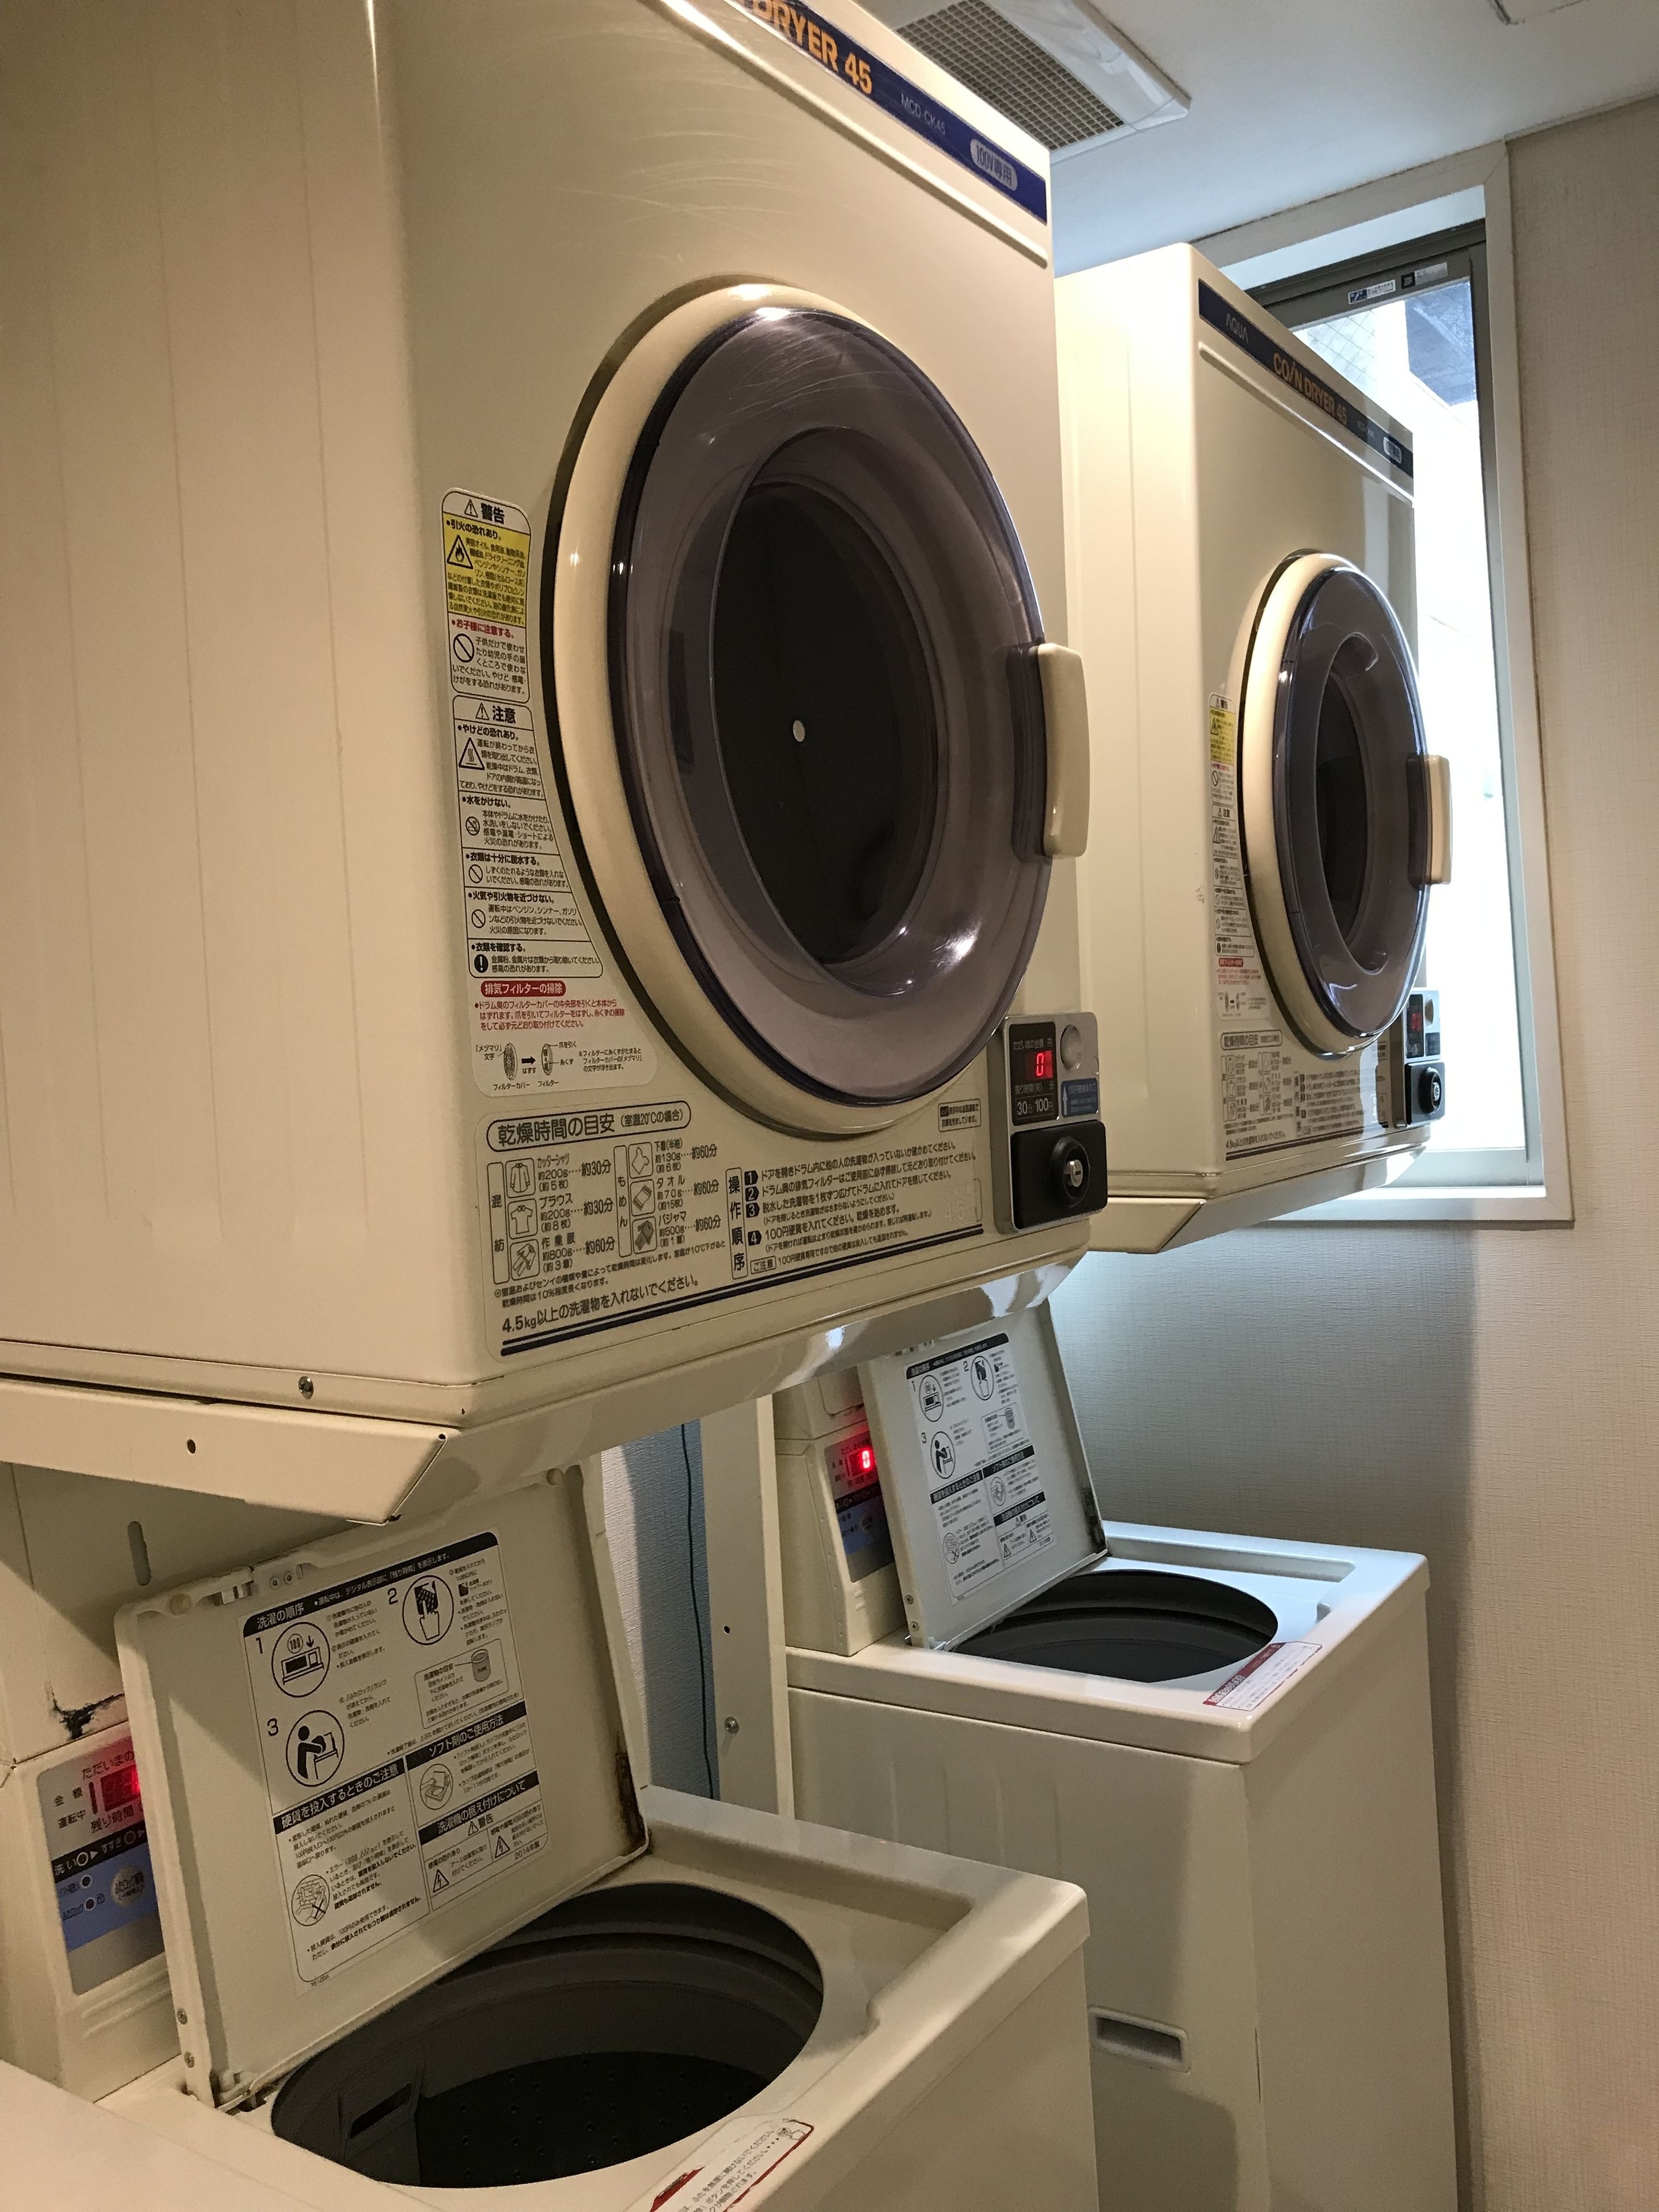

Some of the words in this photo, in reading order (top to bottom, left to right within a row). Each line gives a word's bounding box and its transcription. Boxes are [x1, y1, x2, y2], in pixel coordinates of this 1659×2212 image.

[753, 0, 838, 73] DRYER
[844, 52, 872, 94] 45
[1225, 313, 1249, 344] AQUA
[1304, 377, 1335, 415] DRYER
[1336, 403, 1348, 425] 45
[480, 502, 505, 525] 警告
[450, 518, 502, 541] 引火の恐れあり。
[456, 619, 514, 639] お子様に注意する。
[475, 636, 525, 653] 子供だけで使わせ
[476, 660, 525, 674] くところで使わな
[492, 704, 517, 724] 注意
[463, 725, 519, 741] やけどの恐れあり。
[467, 795, 512, 808] 水をかけない。
[470, 851, 540, 866] 衣類は十分に脱水する。
[472, 892, 555, 904] 火気や引火物を近づけない。
[489, 925, 547, 935] 火災の原因になります。
[475, 942, 526, 953] 衣類を確認する。
[484, 982, 563, 995] 排気フィルターの掃除
[1036, 1052, 1044, 1077] 0
[493, 1082, 531, 1091] フィルターカバー
[537, 1080, 559, 1088] フィルター
[498, 1113, 615, 1147] 乾燥時間の目安
[655, 1152, 681, 1163] 約130g
[691, 1143, 718, 1160] 約60分
[537, 1169, 569, 1180] 約200g
[581, 1159, 612, 1177] 約30分
[656, 1175, 686, 1188] タオル
[657, 1189, 683, 1200] 約70g
[693, 1179, 719, 1196] 約60分
[539, 1192, 574, 1209] ブラウス
[540, 1209, 571, 1221] 約200g
[583, 1197, 613, 1216] 約30分
[659, 1225, 685, 1237] 約500g
[695, 1214, 721, 1232] 約60分
[728, 1175, 745, 1271] 操作順序
[541, 1232, 575, 1249] 作業服
[543, 1248, 573, 1262] 約800g
[585, 1236, 615, 1255] 約60分
[753, 1259, 773, 1271] ご注意
[502, 1273, 698, 1333] 4.5kg以上の洗濯物を入れないでください。
[963, 1360, 969, 1372] 2
[921, 1432, 927, 1444] 3
[387, 1587, 399, 1605] 2
[257, 1602, 305, 1630] 洗濯の順序
[256, 1637, 263, 1654] 1
[289, 1638, 301, 1650] 100
[266, 1718, 279, 1737] 3
[429, 1714, 504, 1757] ソフト剤のご使用方法
[82, 1751, 135, 1781] ただいまの
[281, 1763, 399, 1829] 硬貨を投入するときのご注意
[437, 1779, 526, 1834] 洗濯機の据え付けについて
[58, 1809, 86, 1829] 運転中
[90, 1804, 135, 1834] 残り時間
[477, 1813, 494, 1829] 警告
[101, 1836, 122, 1854] すすぎ
[514, 1840, 540, 1860] 2014年製
[54, 1858, 77, 1876] 洗い
